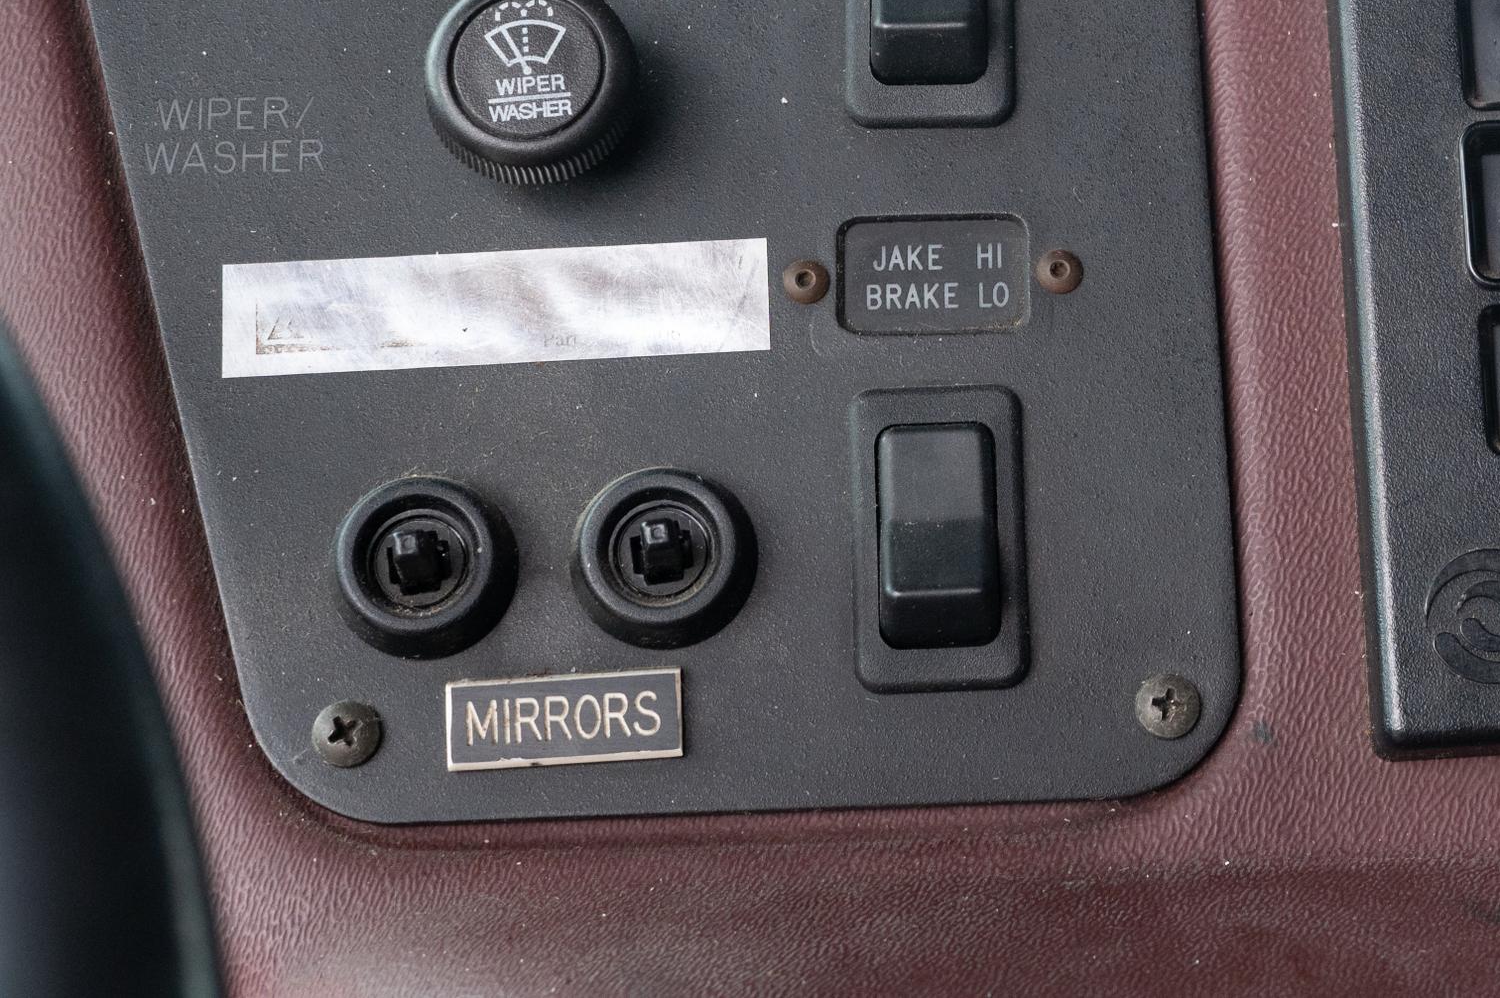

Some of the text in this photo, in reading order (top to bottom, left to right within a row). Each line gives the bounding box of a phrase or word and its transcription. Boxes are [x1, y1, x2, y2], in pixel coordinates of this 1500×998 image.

[495, 74, 566, 96] WIPER
[158, 96, 315, 131] WIPER/
[488, 99, 573, 123] WASHER
[145, 138, 326, 176] WASHER
[872, 242, 1003, 271] JAKE HI
[866, 281, 1010, 311] BRAKE LO
[466, 690, 662, 747] MIRRORS
